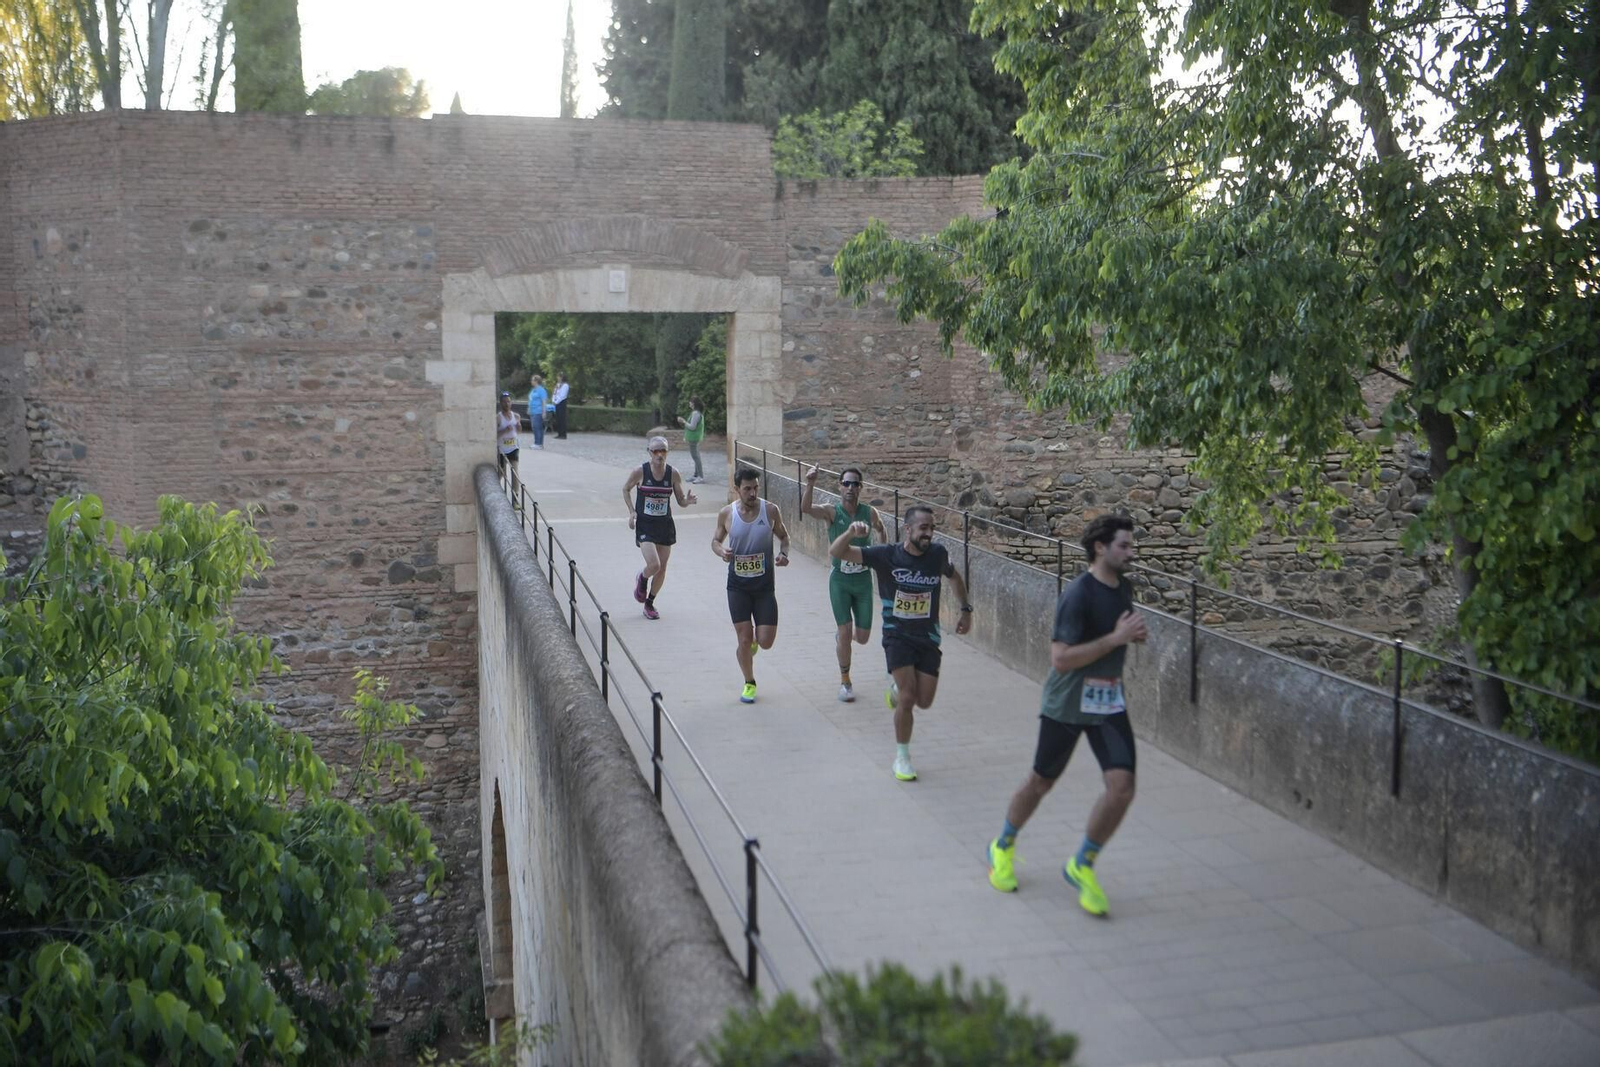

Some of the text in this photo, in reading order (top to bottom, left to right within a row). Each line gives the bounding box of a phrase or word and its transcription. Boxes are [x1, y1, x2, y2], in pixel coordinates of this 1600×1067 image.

[646, 502, 664, 511] 4987
[736, 560, 761, 571] 5636
[892, 568, 940, 585] Balance
[896, 599, 926, 611] 2917
